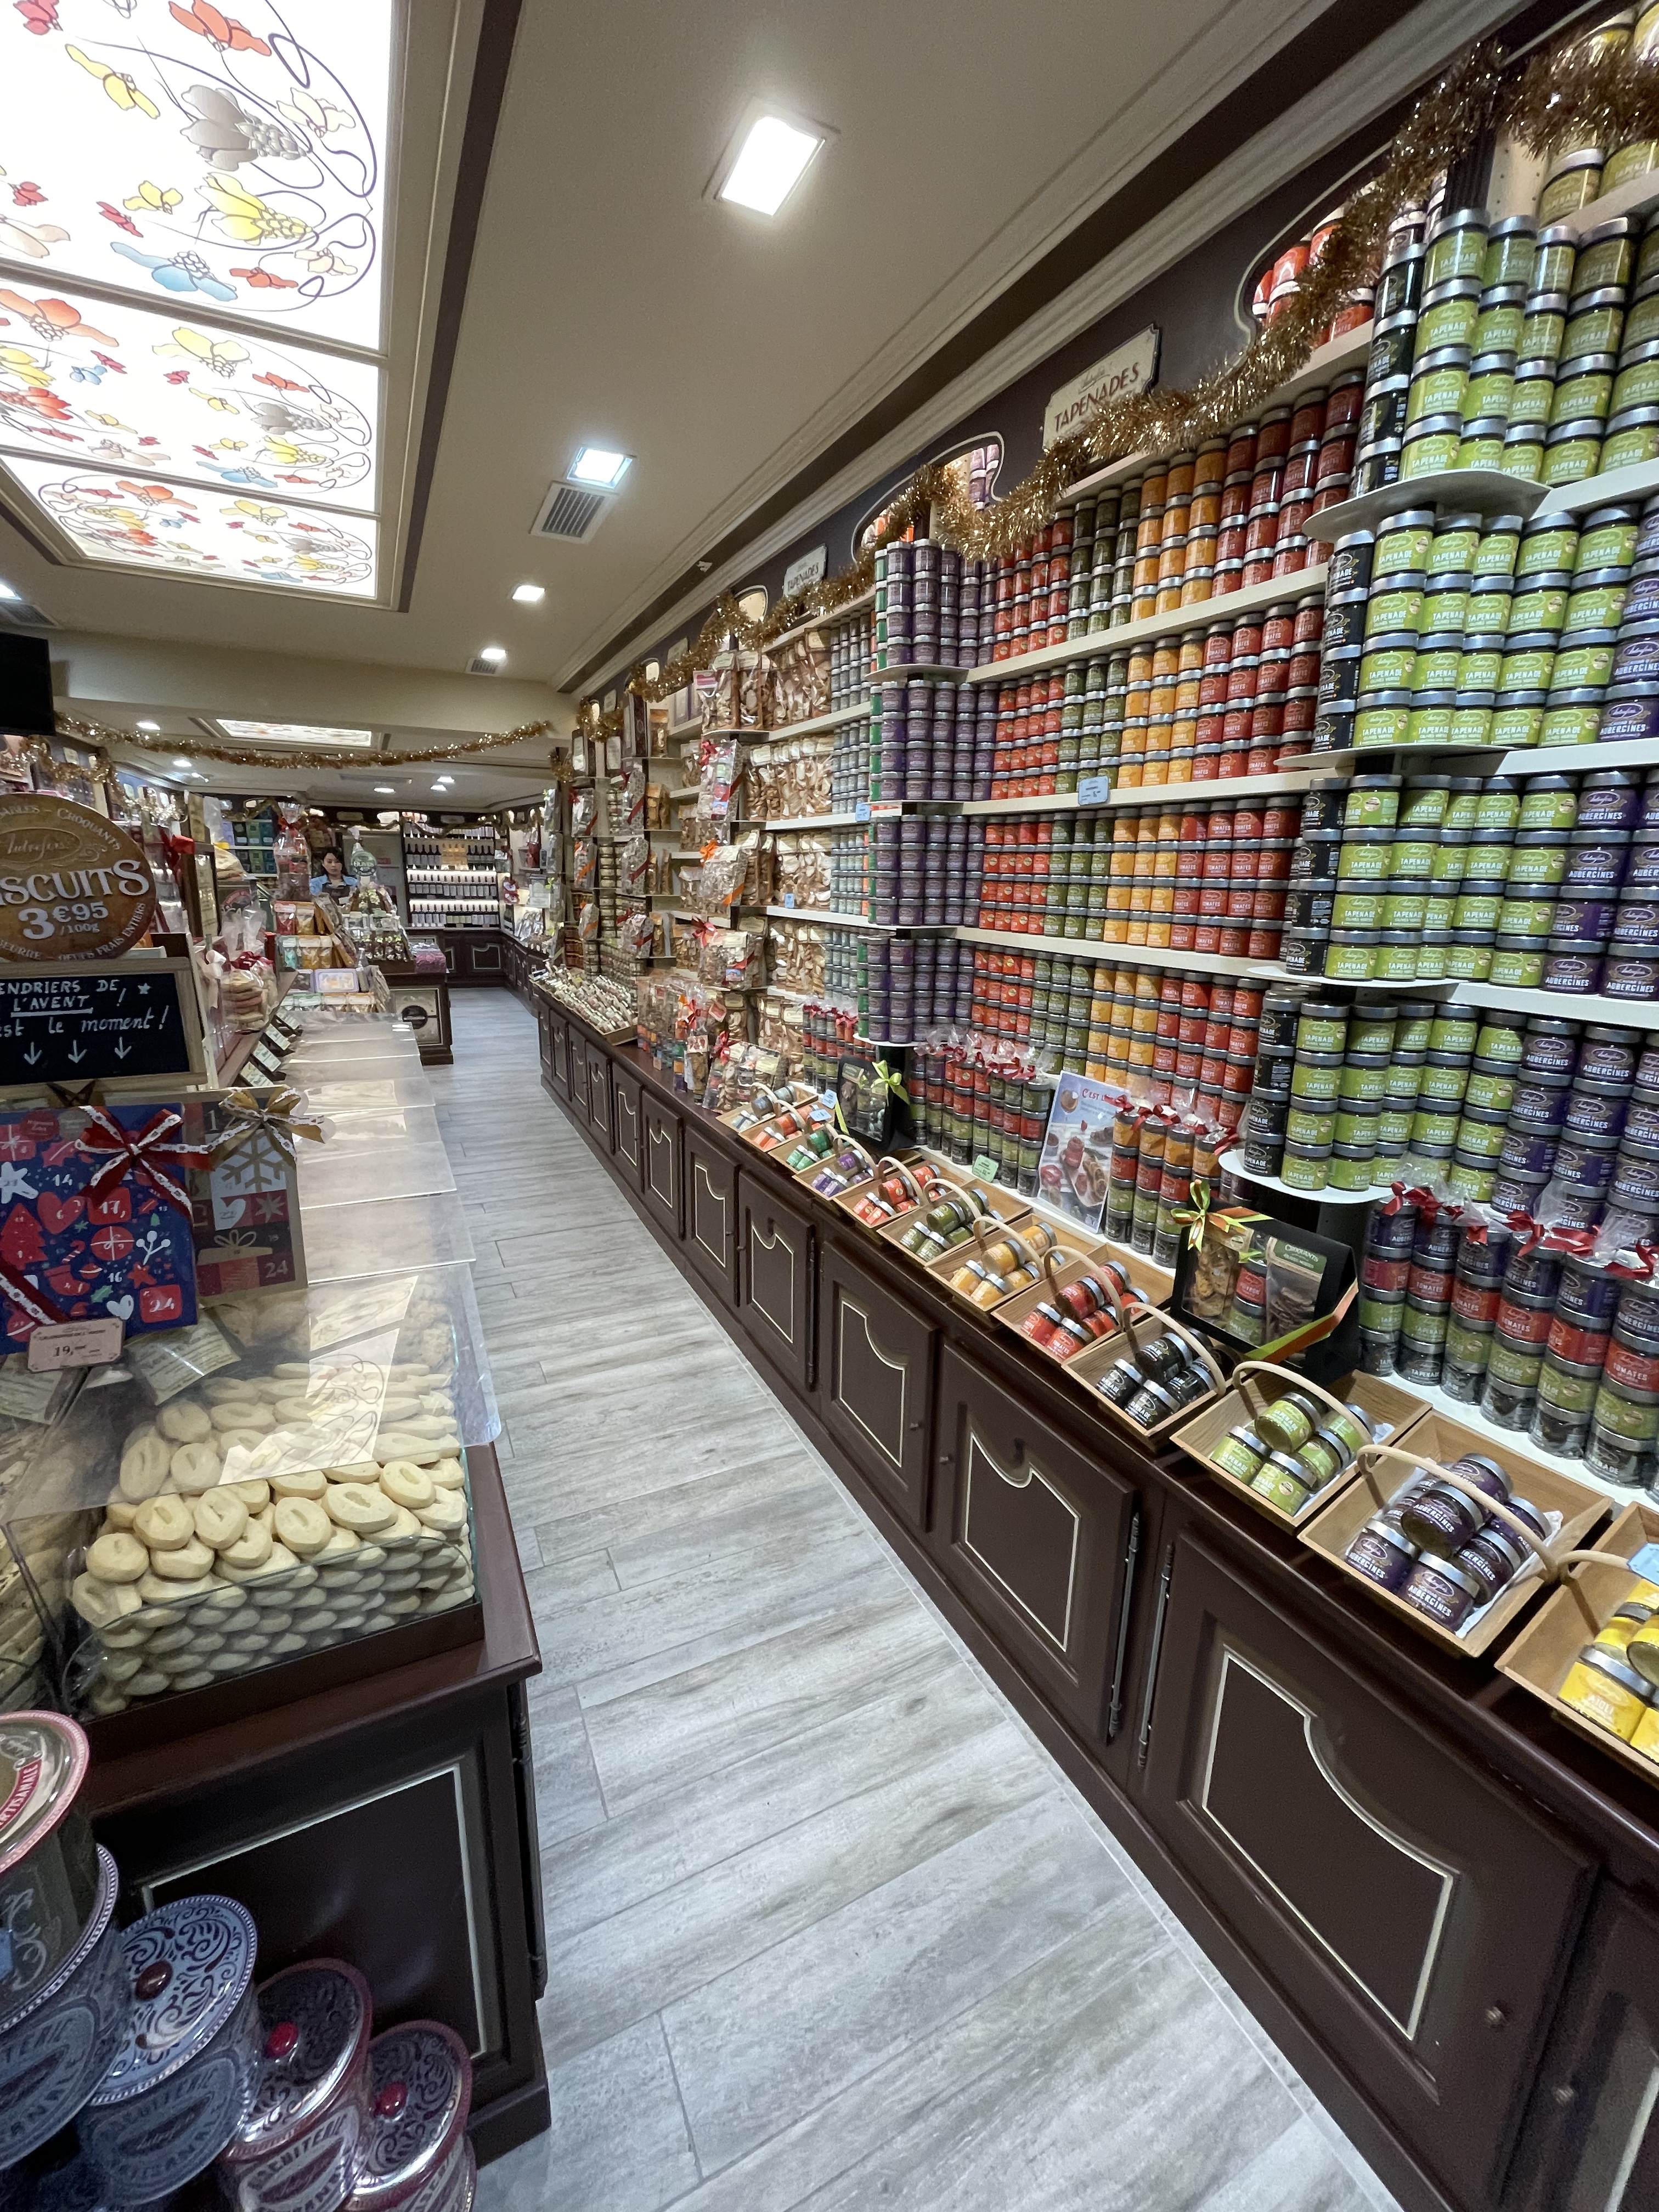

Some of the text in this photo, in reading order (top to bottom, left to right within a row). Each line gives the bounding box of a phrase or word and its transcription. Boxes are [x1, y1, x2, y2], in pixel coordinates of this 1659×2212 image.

[1431, 322, 1466, 337] TAPENADE
[1054, 362, 1139, 432] TAPENADES
[1425, 391, 1460, 404] TAPENADE
[1412, 454, 1448, 468] TAPENADE
[1551, 460, 1588, 473] TAPENADE
[1379, 550, 1412, 563] TAPENADE
[1432, 550, 1468, 563] TAPENADE
[1525, 550, 1562, 561] TAPENADE
[1583, 546, 1621, 558] TAPENADE
[1477, 555, 1511, 564] TAPENADE
[1373, 611, 1407, 622] TAPENADE
[1468, 612, 1502, 622] TAPENADE
[1570, 608, 1607, 620] TAPENADE
[1369, 668, 1402, 680] TAPENADE
[1506, 670, 1542, 680] TAPENADE
[1362, 726, 1395, 736] TAPENADE
[1451, 726, 1484, 735] TAPENADE
[1495, 725, 1530, 735] TAPENADE
[1545, 726, 1582, 736] TAPENADE
[1600, 724, 1646, 736] AUBERGINES
[1412, 805, 1443, 813] TAPENADE
[1578, 812, 1623, 820] AUBERGINES
[57, 808, 120, 850] CROQUANTS
[1401, 857, 1431, 866] TAPENADE
[1568, 871, 1615, 879] AUBERGINES
[0, 859, 149, 905] SCUITS
[1393, 910, 1424, 918] TAPENADE
[1464, 911, 1496, 919] TAPENADE
[95, 936, 125, 955] FRAIS
[122, 903, 146, 936] ENTIERS
[0, 979, 120, 995] ENDRIERS DE
[1545, 977, 1589, 987] AUBERGINES
[1606, 981, 1655, 993] AUBERGINES
[13, 995, 89, 1011] L'AVENT
[1305, 1034, 1334, 1043] TAPENADE
[1443, 1035, 1472, 1043] TAPENADE
[1526, 1054, 1568, 1066] AUBERGINES
[1583, 1065, 1629, 1077] AUBERGINES
[1389, 1080, 1418, 1088] TAPENADE
[1429, 1081, 1459, 1090] TAPENADE
[1291, 1126, 1318, 1136] TAPENADE
[53, 1174, 73, 1186] 14
[1284, 1244, 1319, 1262] CROQUANTS
[264, 1260, 288, 1278] 24
[108, 1272, 122, 1282] 16
[149, 1297, 176, 1312] 24
[1613, 1364, 1648, 1381] TOMATES
[1408, 1585, 1452, 1617] AUBERGINES
